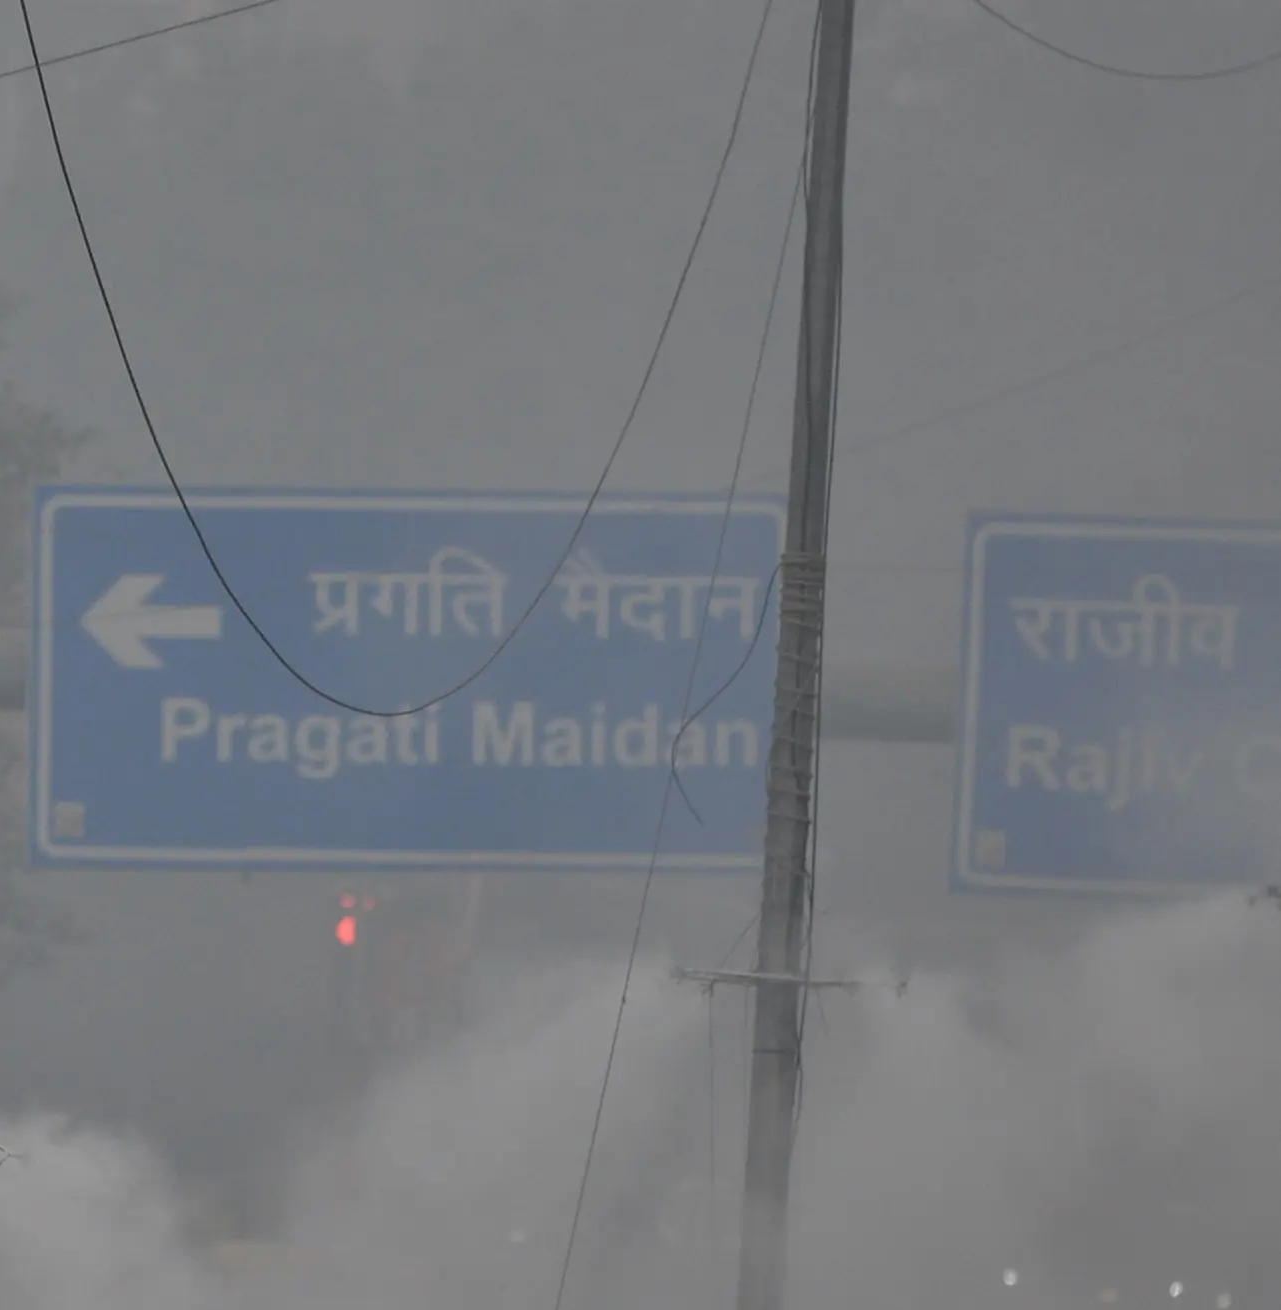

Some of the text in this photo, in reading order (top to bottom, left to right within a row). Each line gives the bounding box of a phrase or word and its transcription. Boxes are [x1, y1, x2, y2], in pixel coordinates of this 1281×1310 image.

[309, 545, 762, 642] प्रगति मैदान
[1010, 573, 1239, 671] राजीव
[161, 697, 758, 780] Pragati Maidan
[1006, 722, 1204, 811] Rajiv
